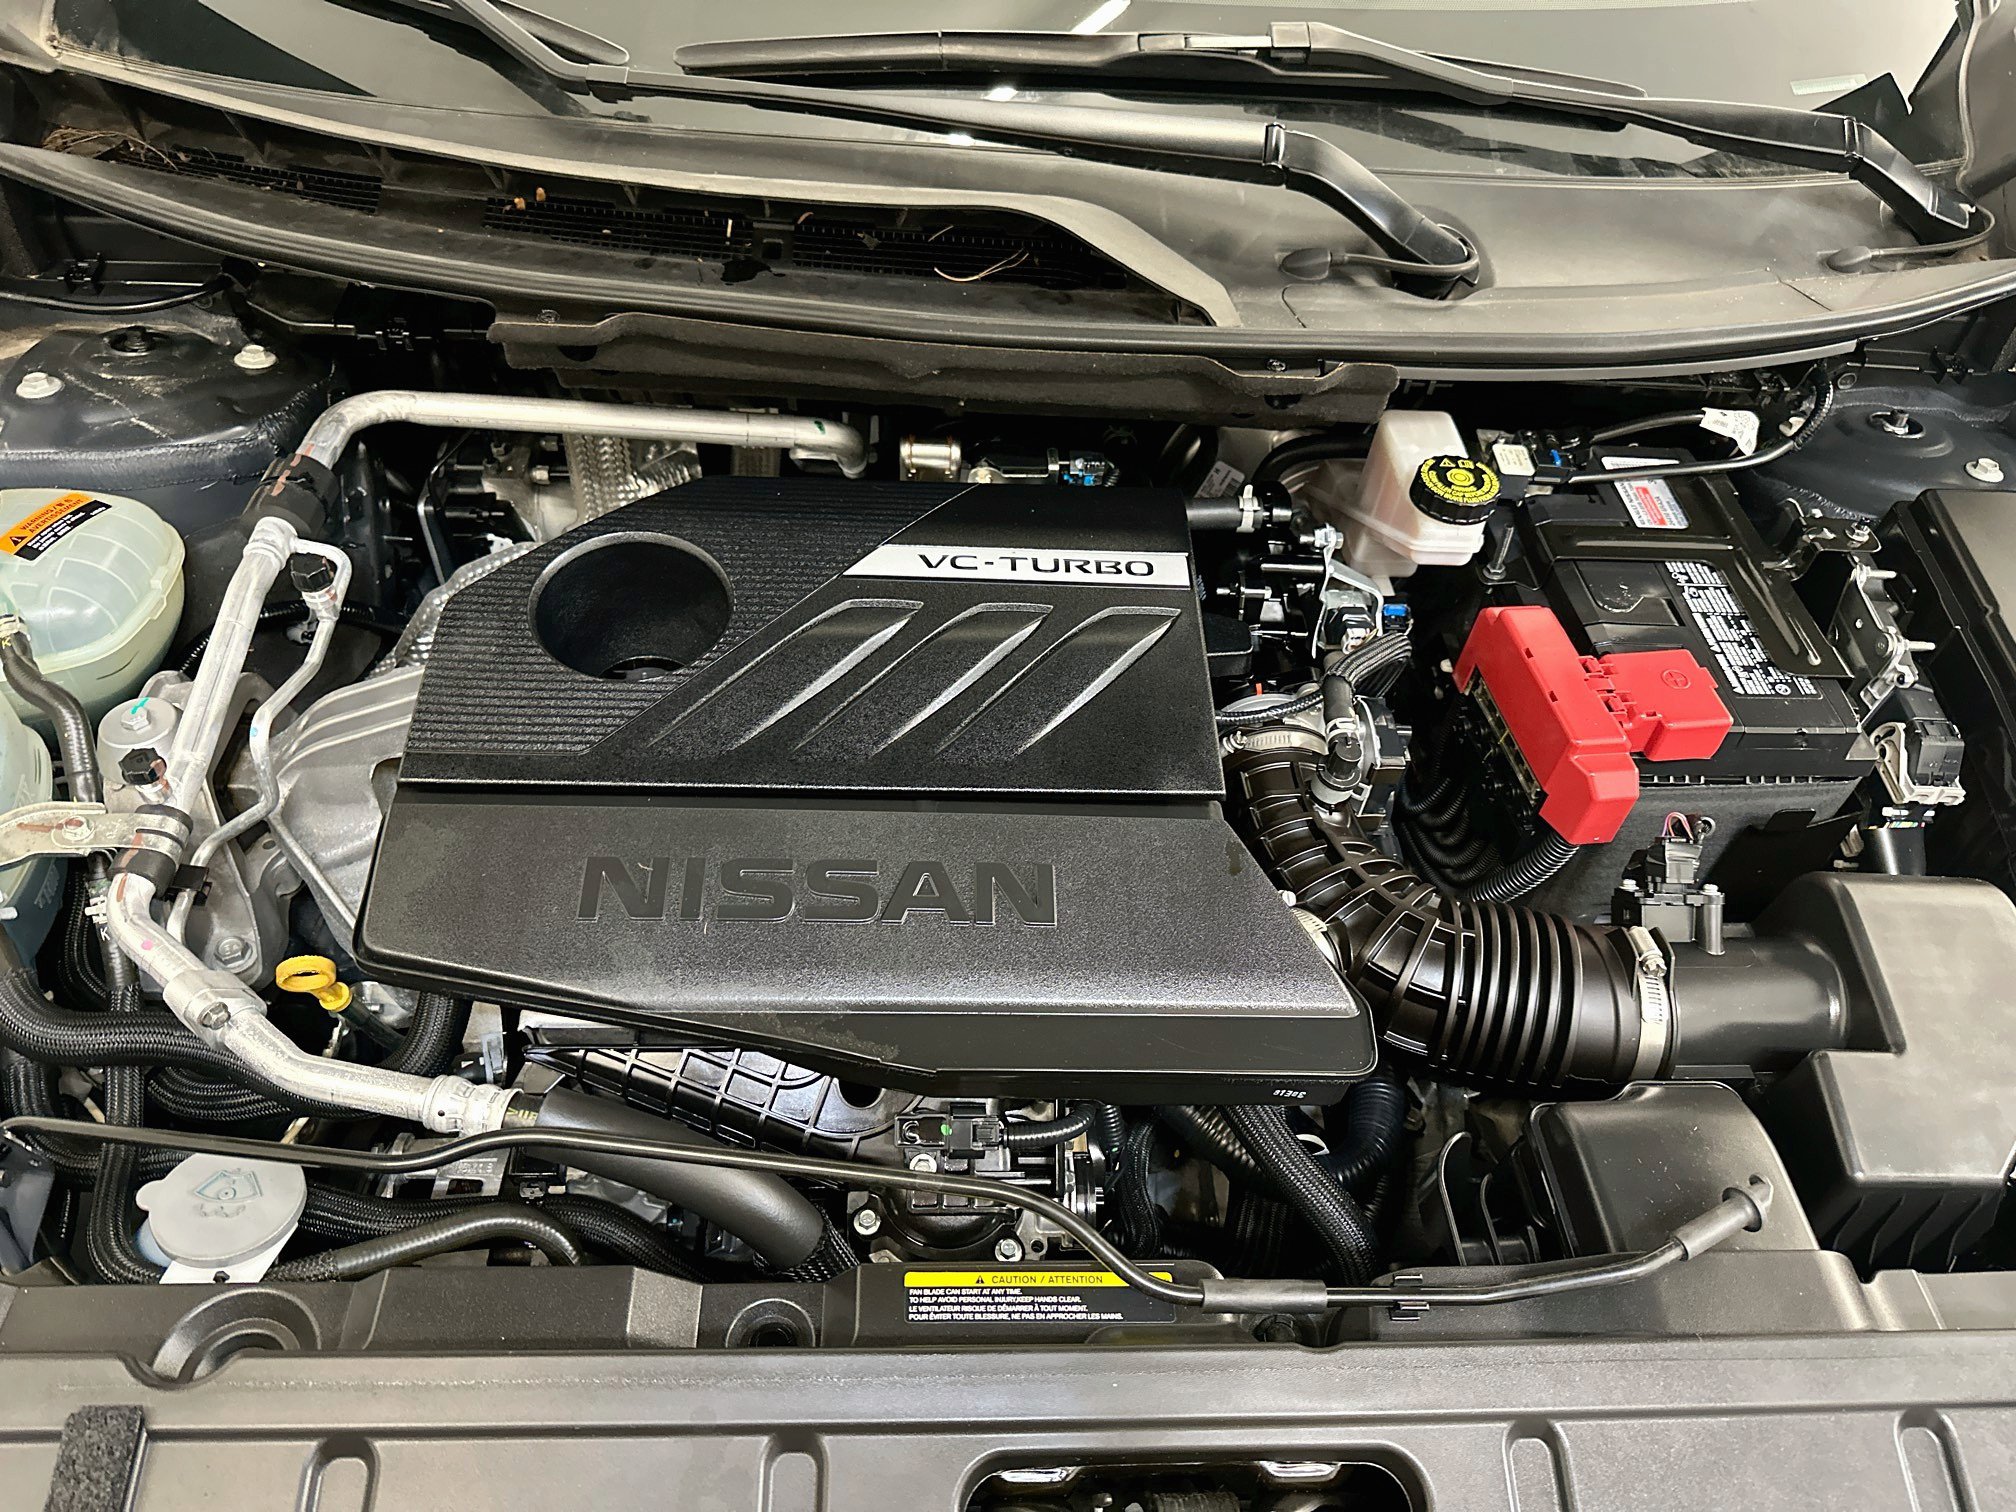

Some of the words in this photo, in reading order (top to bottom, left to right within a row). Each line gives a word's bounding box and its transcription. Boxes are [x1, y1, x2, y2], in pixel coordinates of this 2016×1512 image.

[29, 499, 83, 533] AVERTISSEMENT
[918, 554, 1154, 577] VC-TURBO
[576, 856, 1058, 927] NISSAN
[991, 1275, 1037, 1284] CAUTION
[1048, 1275, 1103, 1284] ATTENTION
[929, 1311, 951, 1320] ÉVITER
[997, 1303, 1034, 1312] DÉMARRER
